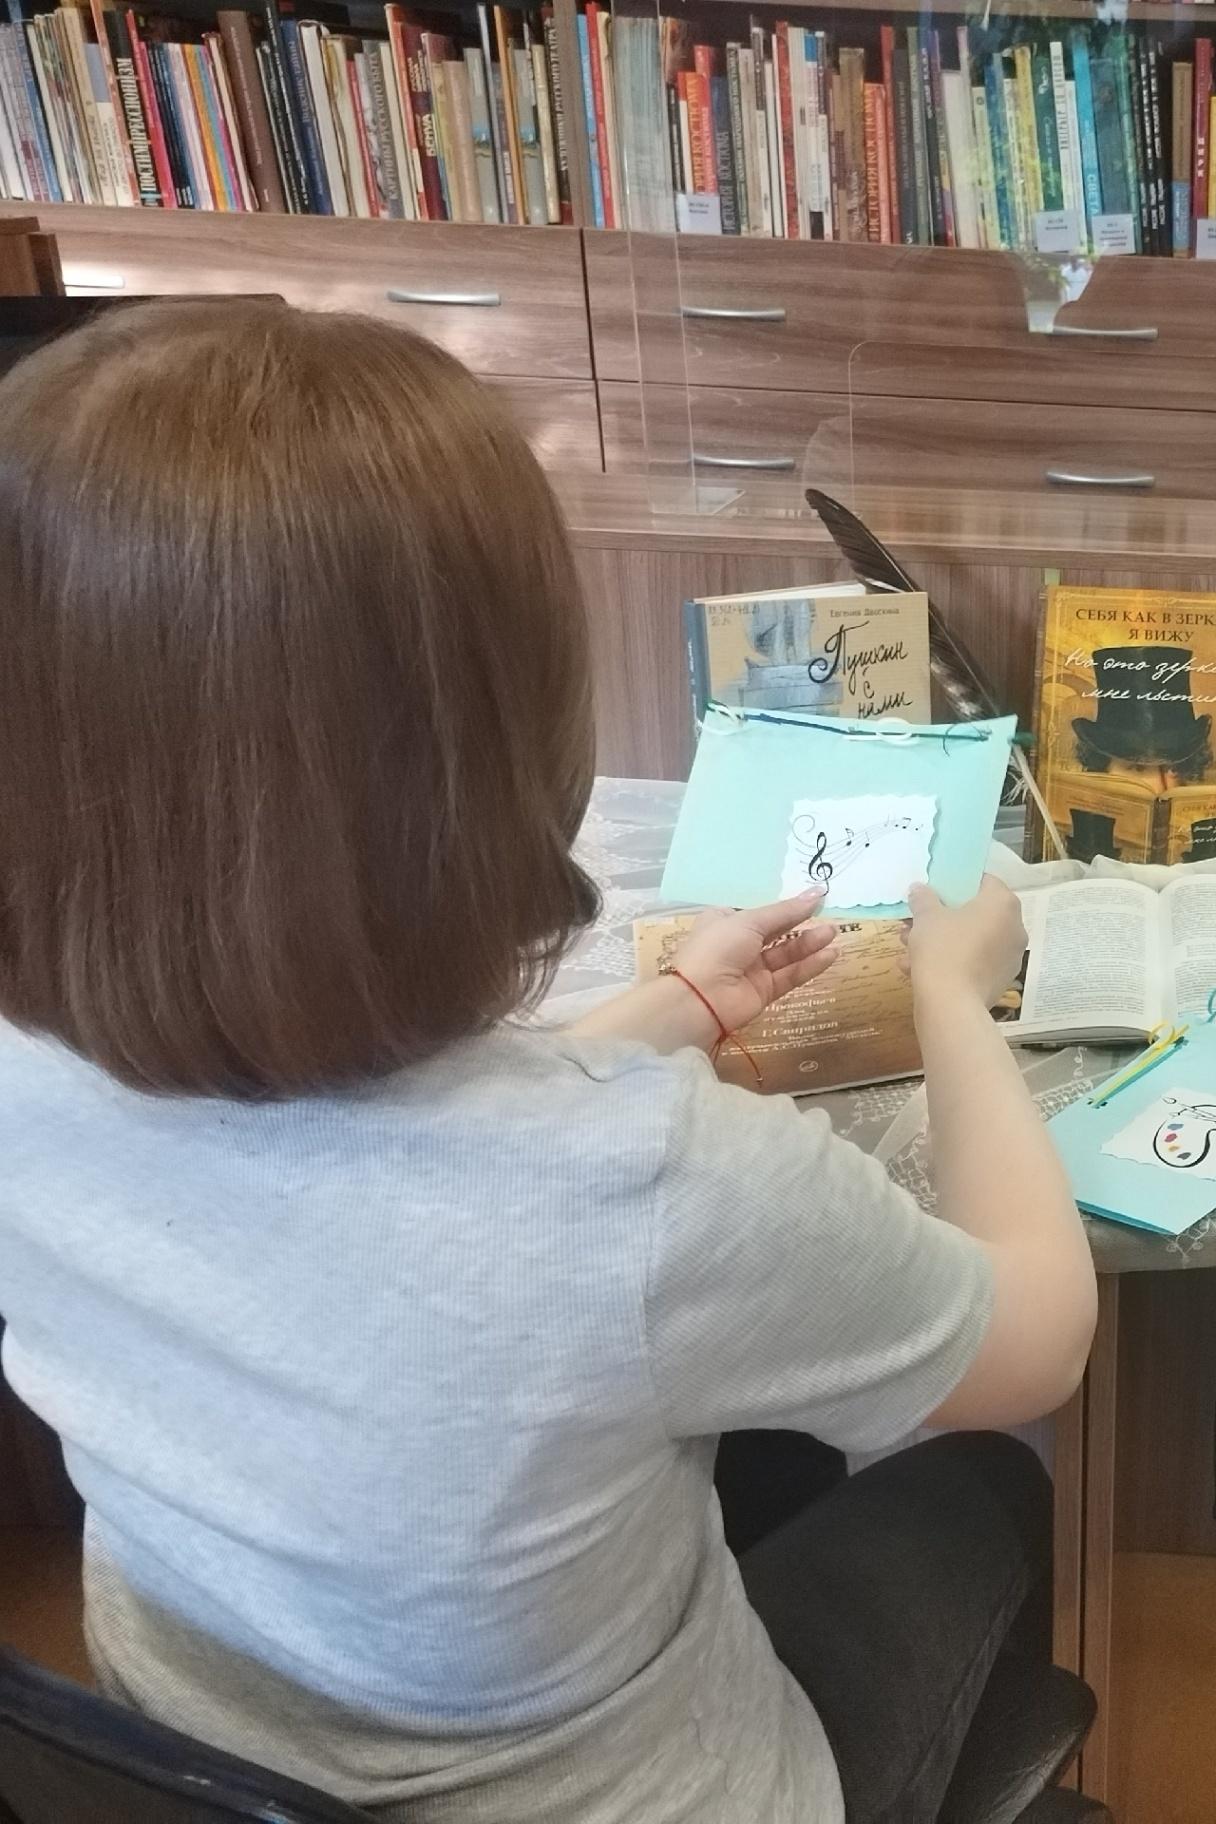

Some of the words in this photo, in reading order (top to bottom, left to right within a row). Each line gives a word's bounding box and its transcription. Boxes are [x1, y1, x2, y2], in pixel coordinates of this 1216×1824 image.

[117, 57, 157, 193] ПОСТИМПРЕССИОНИЗМ
[421, 113, 437, 157] БЕНУА
[685, 78, 702, 153] КОСТЮМА
[864, 87, 877, 164] КОСТЮМА
[721, 184, 737, 232] ИСТОРИЯ
[867, 167, 880, 233] ИСТОРИЯ
[1075, 608, 1117, 621] СЕБЯ
[1123, 610, 1157, 624] КАК
[1162, 612, 1172, 624] В
[1128, 628, 1139, 640] Я
[1144, 629, 1195, 643] ВИЖУ
[808, 621, 908, 696] Пушкин
[1065, 648, 1098, 667] Но
[1103, 657, 1149, 671] это
[857, 691, 913, 719] нами
[1082, 687, 1130, 700] мне
